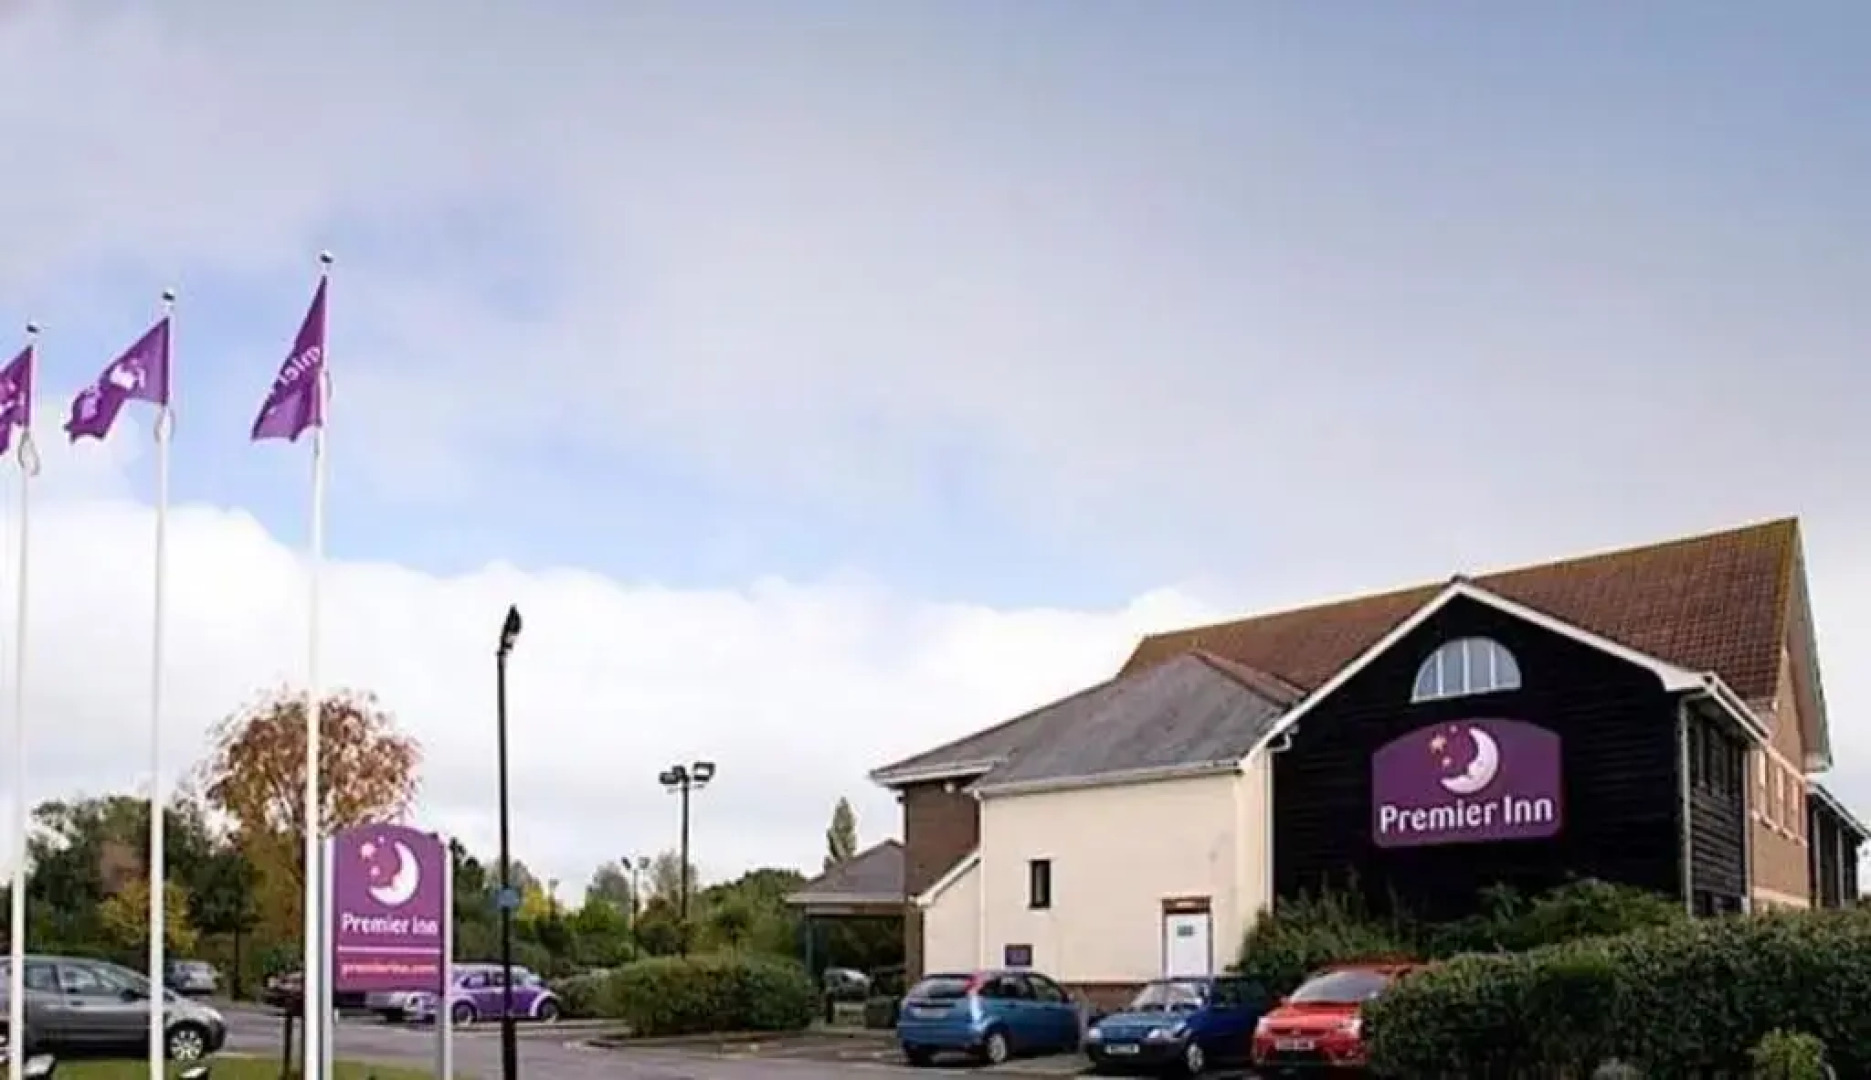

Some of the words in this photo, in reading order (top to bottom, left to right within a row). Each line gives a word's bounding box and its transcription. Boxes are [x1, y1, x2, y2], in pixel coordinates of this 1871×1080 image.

[1380, 799, 1498, 834] Premier
[1503, 795, 1553, 824] Inn
[341, 912, 409, 935] Premier
